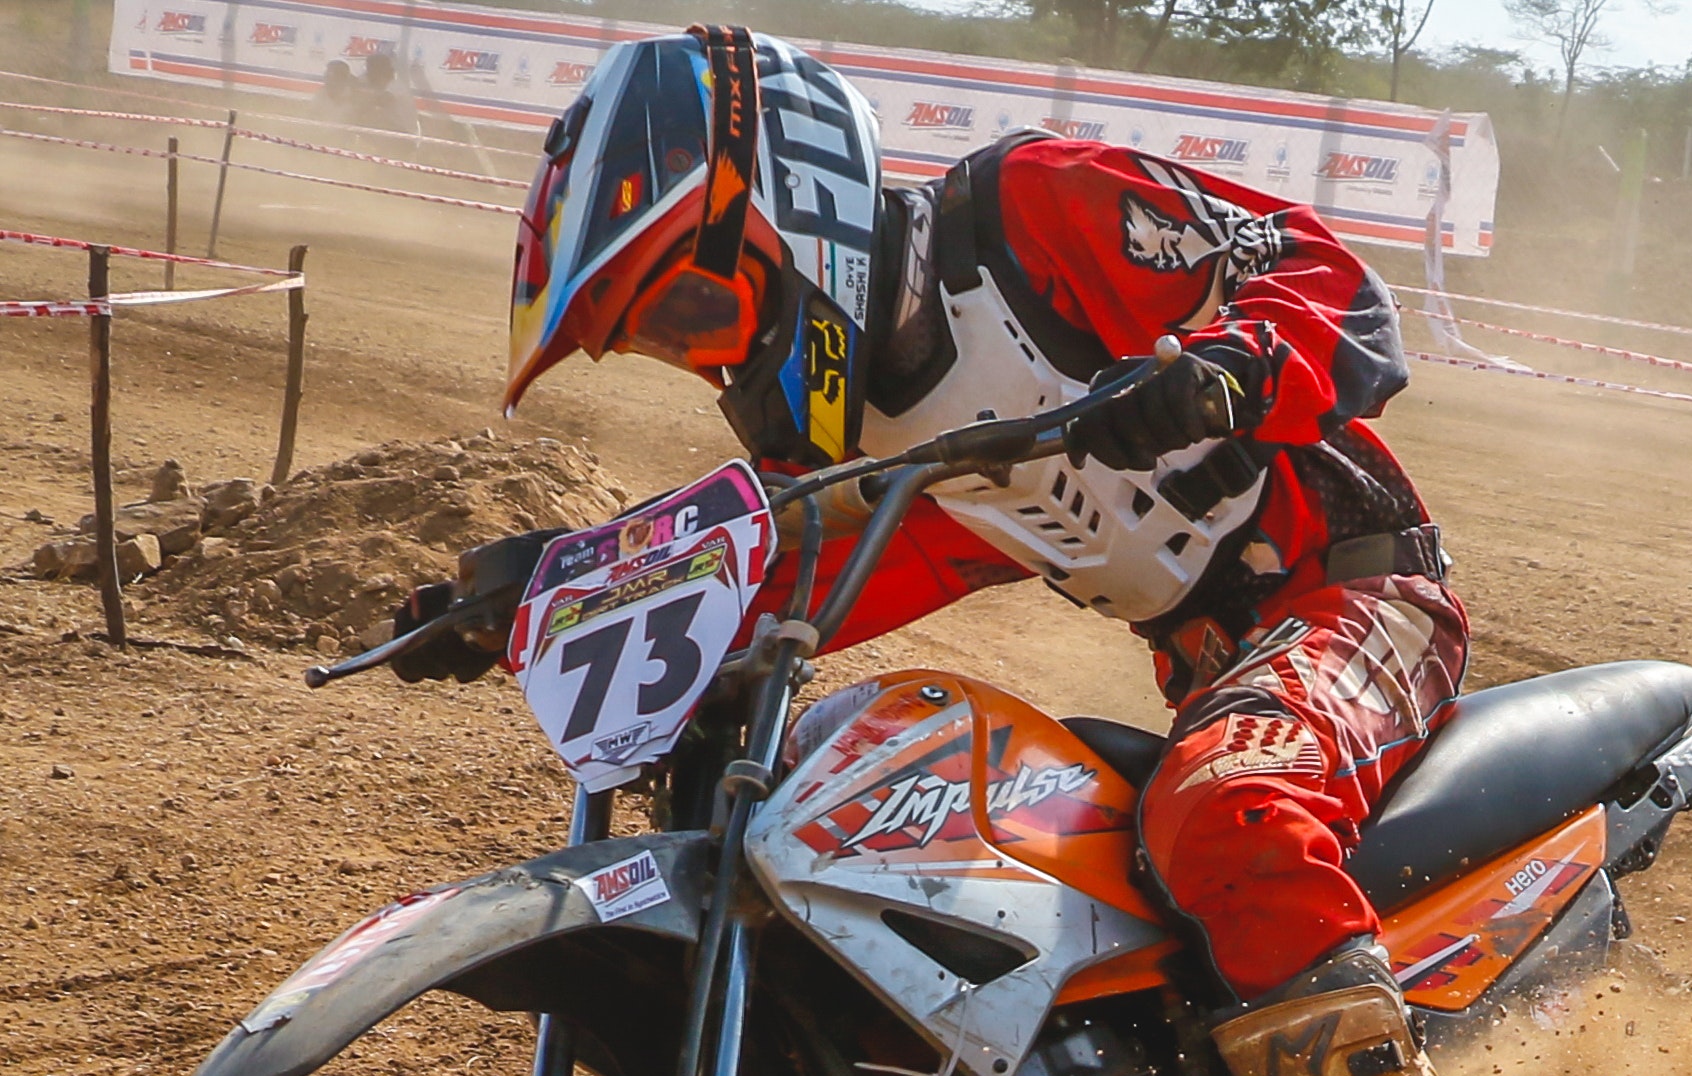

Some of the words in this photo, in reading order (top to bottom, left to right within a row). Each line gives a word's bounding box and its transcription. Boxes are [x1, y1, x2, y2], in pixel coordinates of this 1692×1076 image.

[905, 102, 973, 127] AMSOIL
[1171, 134, 1249, 162] AMSOIL
[1317, 152, 1398, 181] AMSOIL
[854, 271, 867, 320] SHASHI
[560, 546, 594, 569] Team
[559, 589, 705, 745] 73
[592, 856, 656, 902] AMSOIL
[1504, 858, 1548, 896] Hero
